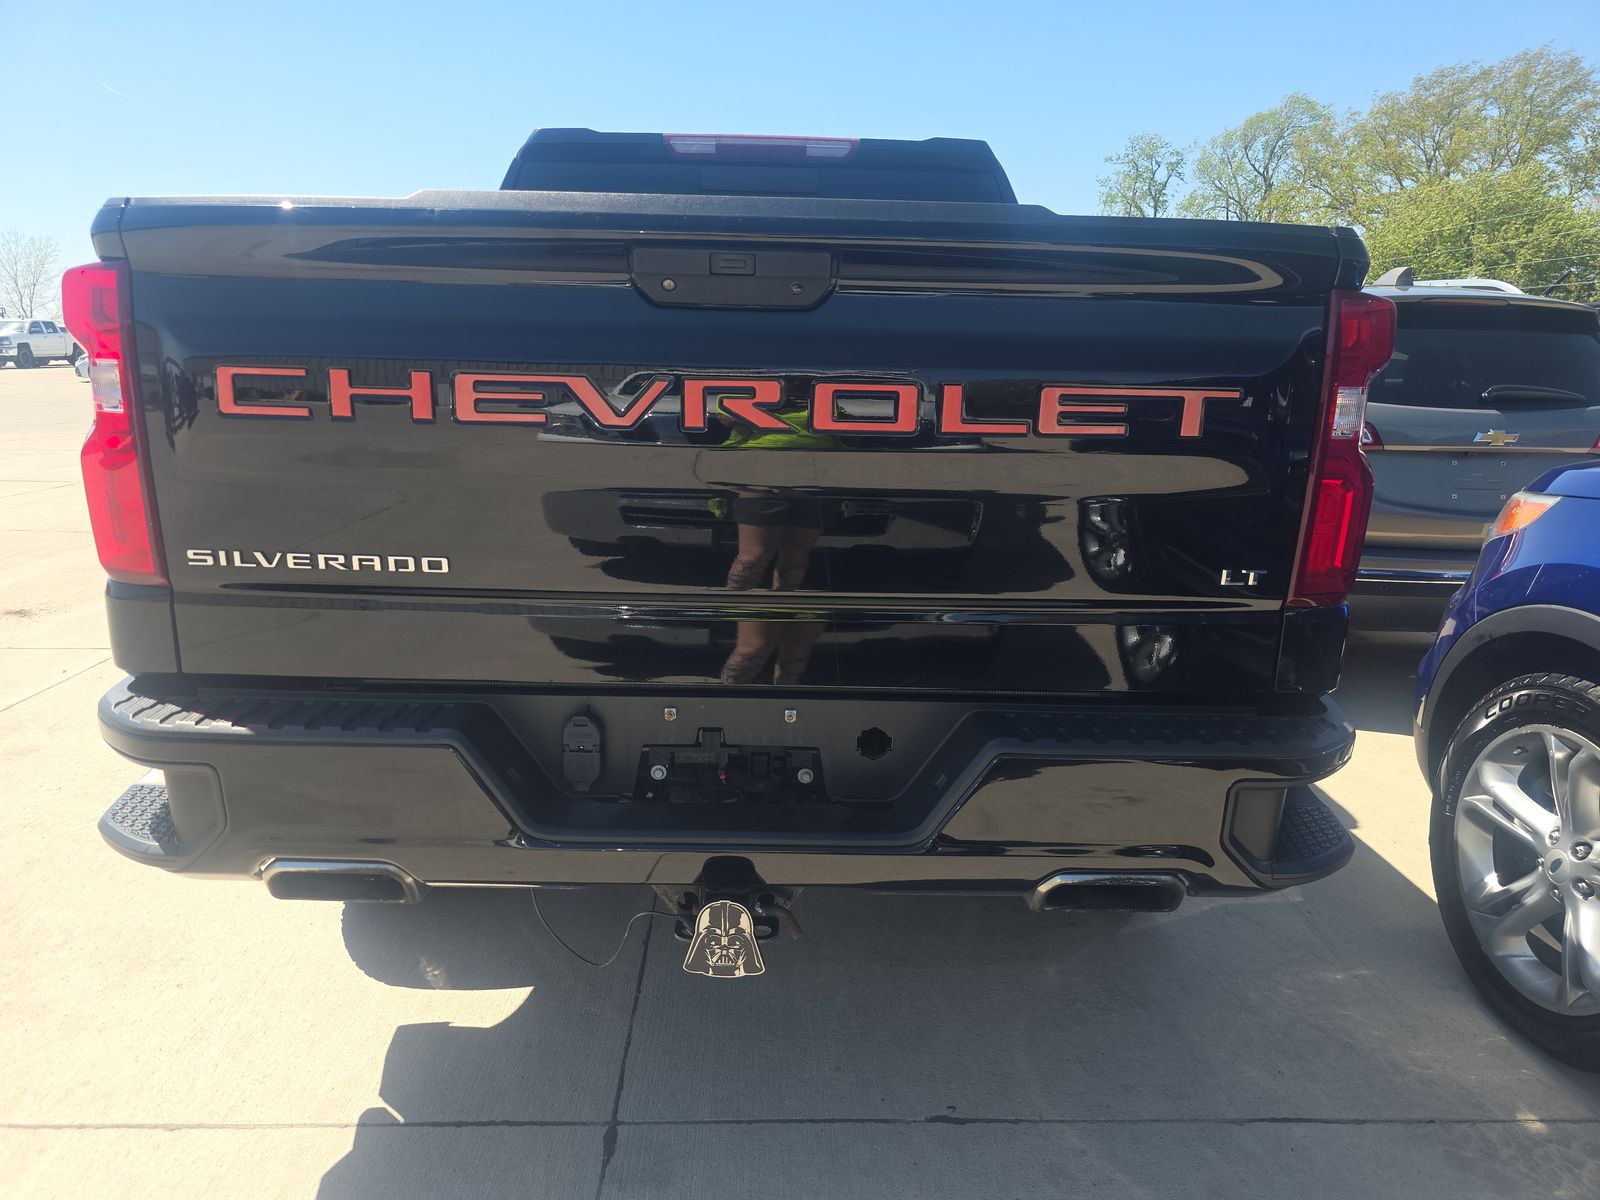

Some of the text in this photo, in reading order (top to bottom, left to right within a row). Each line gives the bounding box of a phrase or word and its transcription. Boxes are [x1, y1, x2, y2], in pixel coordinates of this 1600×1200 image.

[215, 365, 1242, 439] CHEVROLET
[186, 549, 450, 574] SILVERADO
[1220, 569, 1267, 586] LT
